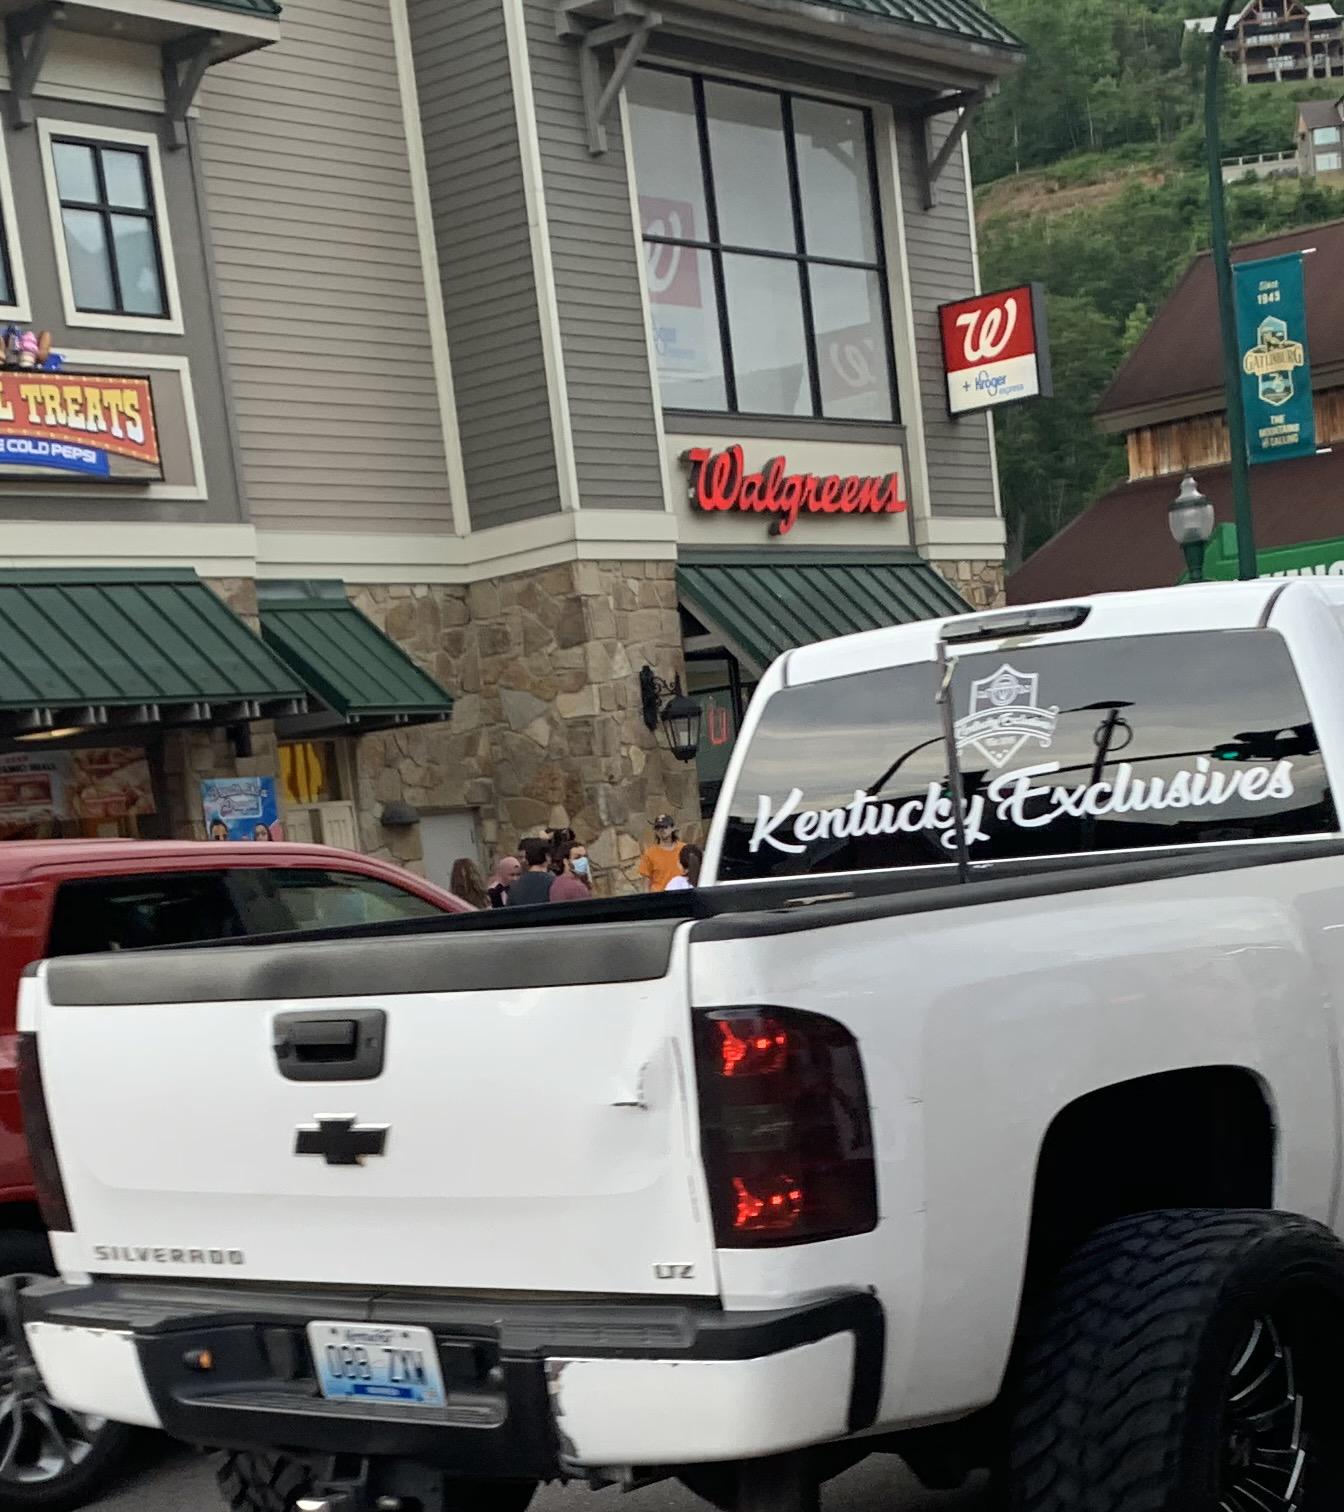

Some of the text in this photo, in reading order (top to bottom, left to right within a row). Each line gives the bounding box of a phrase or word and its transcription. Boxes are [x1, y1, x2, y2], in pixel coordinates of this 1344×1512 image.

[956, 297, 1017, 362] W
[1245, 345, 1303, 372] GATLINBURG
[976, 370, 1007, 396] Kroger
[21, 384, 145, 444] TREATS
[7, 439, 49, 454] COLD
[51, 444, 96, 464] PEPSI
[687, 443, 907, 536] Walgreens
[749, 757, 1294, 853] Kentucky Exclusives
[94, 1245, 244, 1265] SILVERADO
